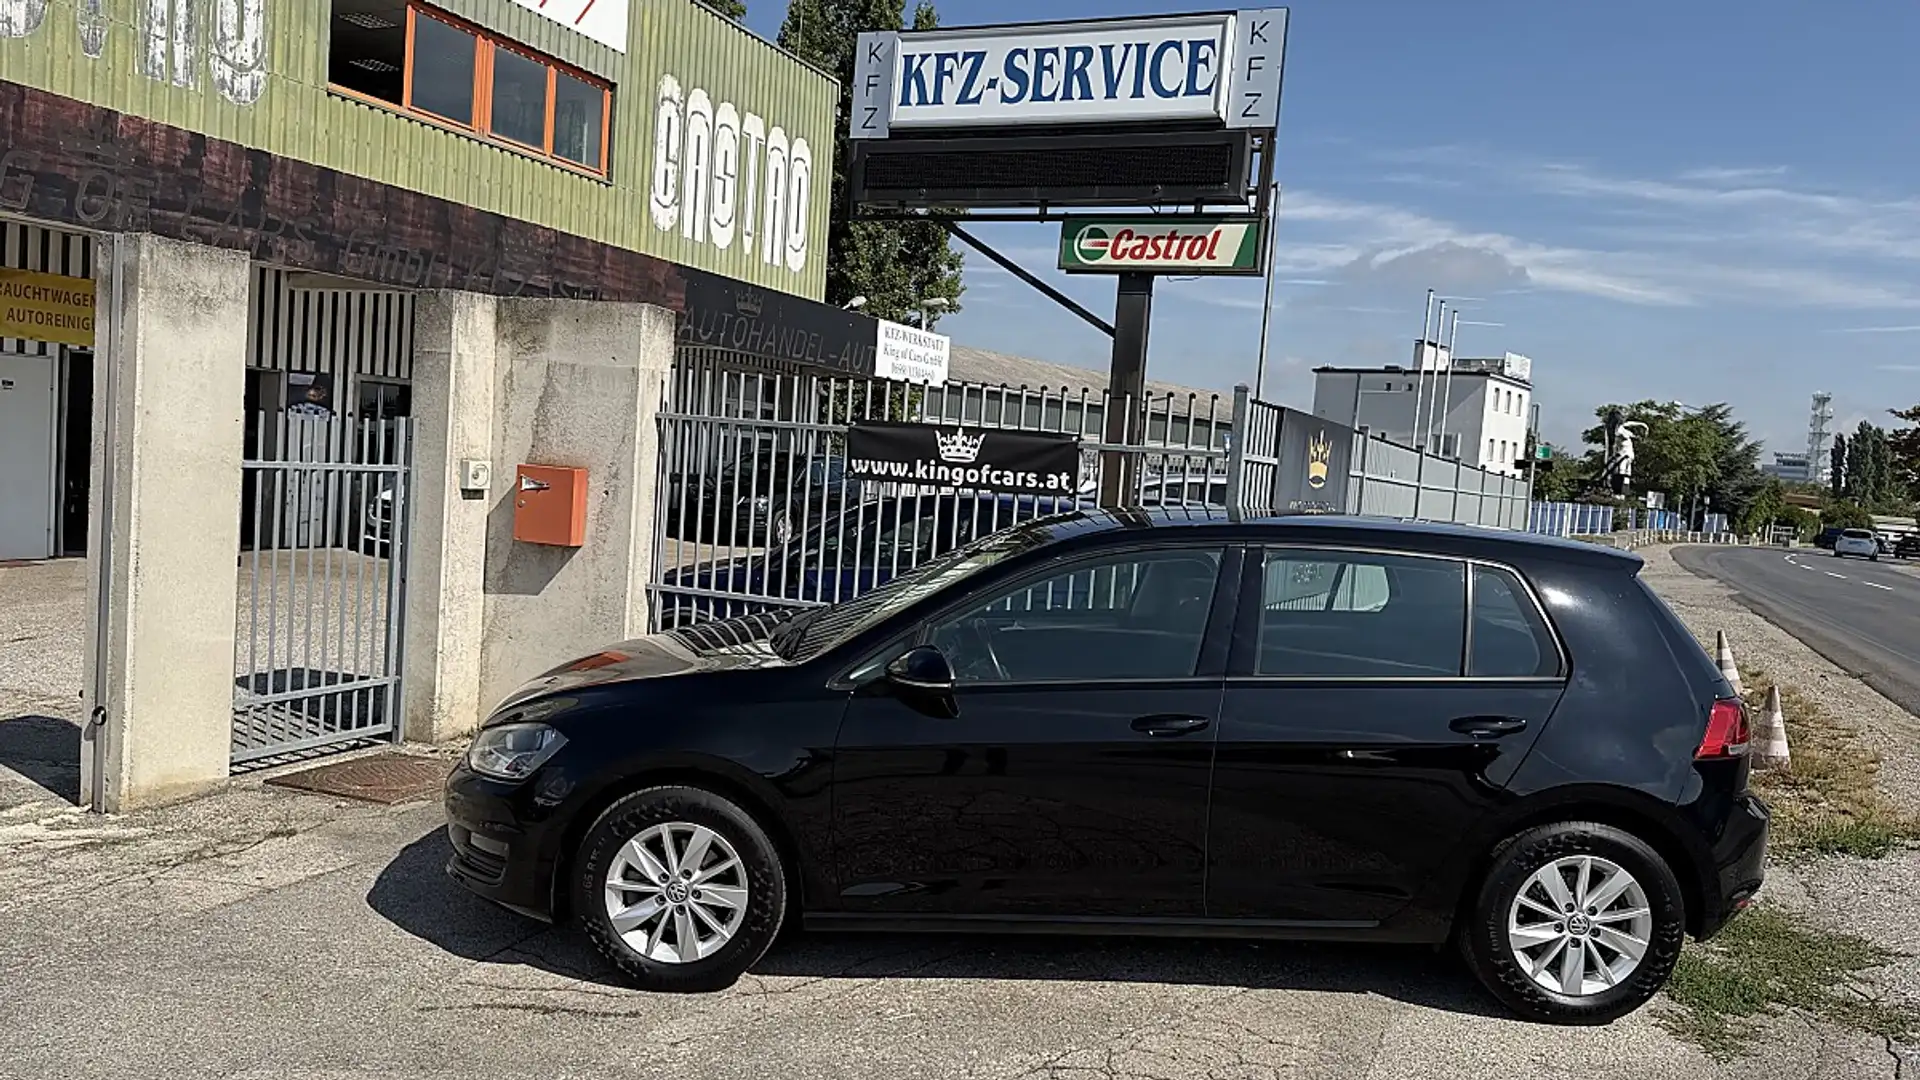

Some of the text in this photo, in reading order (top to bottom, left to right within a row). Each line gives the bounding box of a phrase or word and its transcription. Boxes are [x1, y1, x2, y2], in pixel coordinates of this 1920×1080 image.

[860, 41, 884, 130] KFZ
[899, 38, 1217, 106] KFZ-SERVICE
[1241, 20, 1270, 118] KFZ
[1110, 228, 1222, 261] Castrol
[0, 281, 96, 308] AUCHTWAGEN
[851, 458, 1074, 489] www.kingofcars.at
